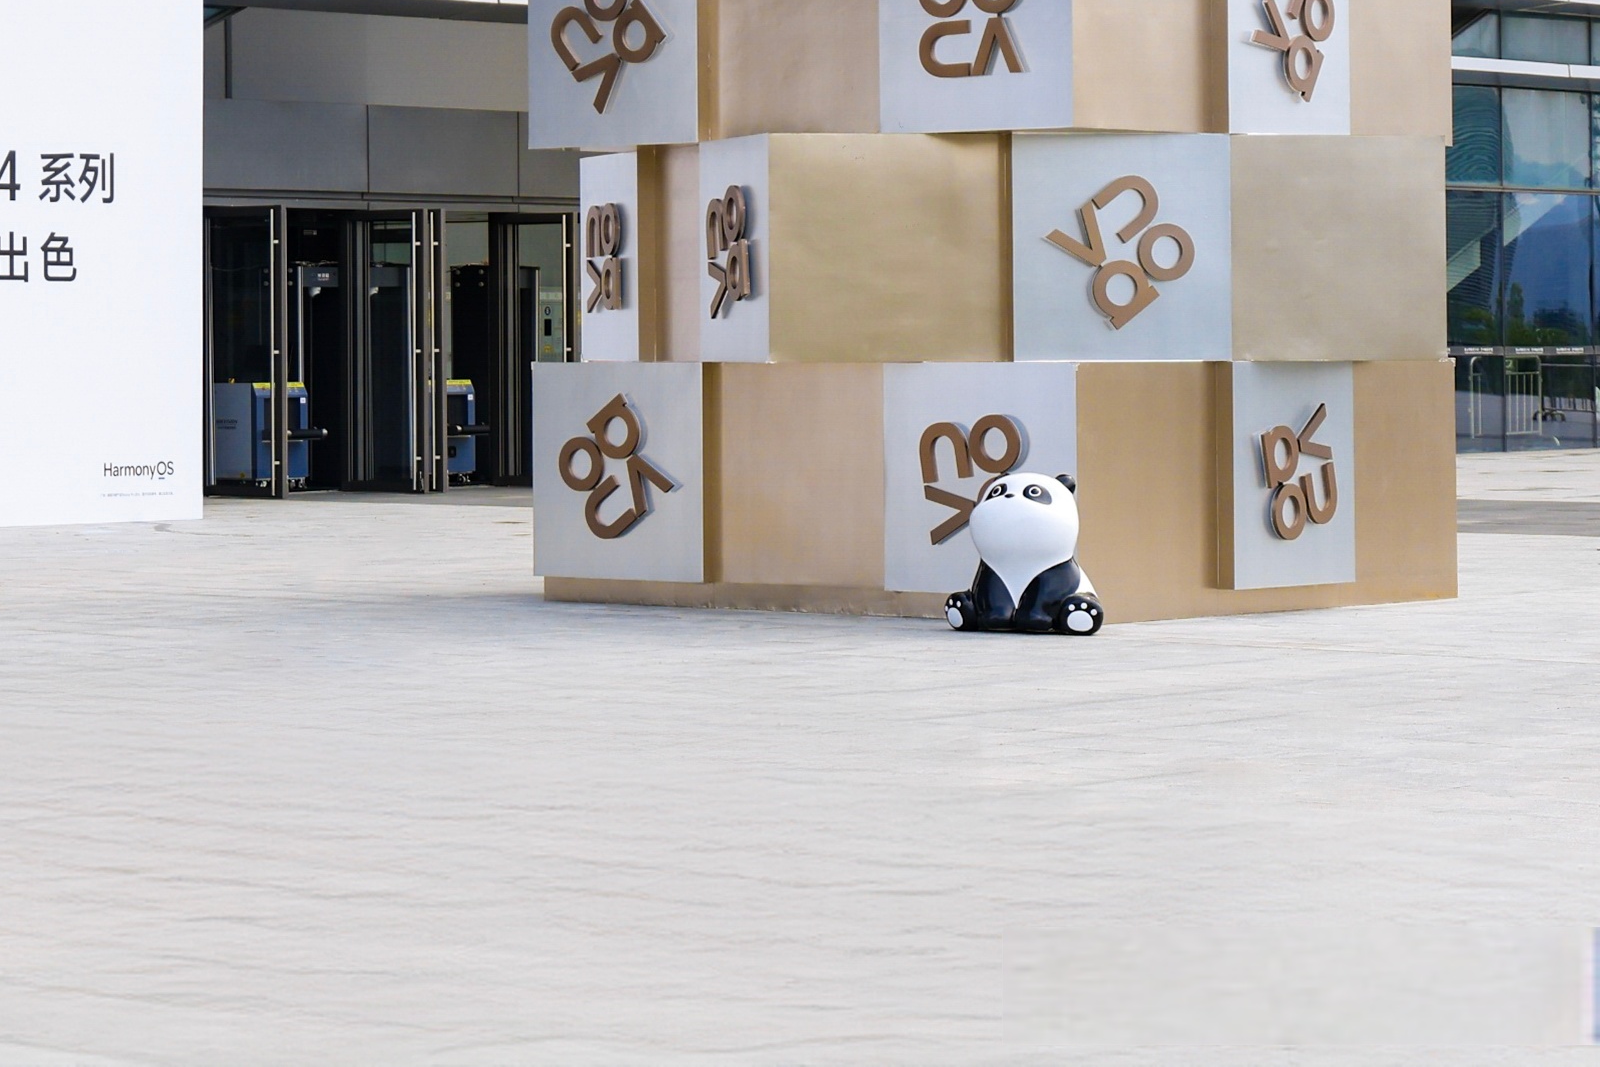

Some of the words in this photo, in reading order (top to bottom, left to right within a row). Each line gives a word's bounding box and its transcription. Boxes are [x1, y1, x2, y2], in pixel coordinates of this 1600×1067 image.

[38, 152, 115, 204] 系列
[103, 461, 175, 480] HarmonyOS
[919, 414, 1022, 546] nov
